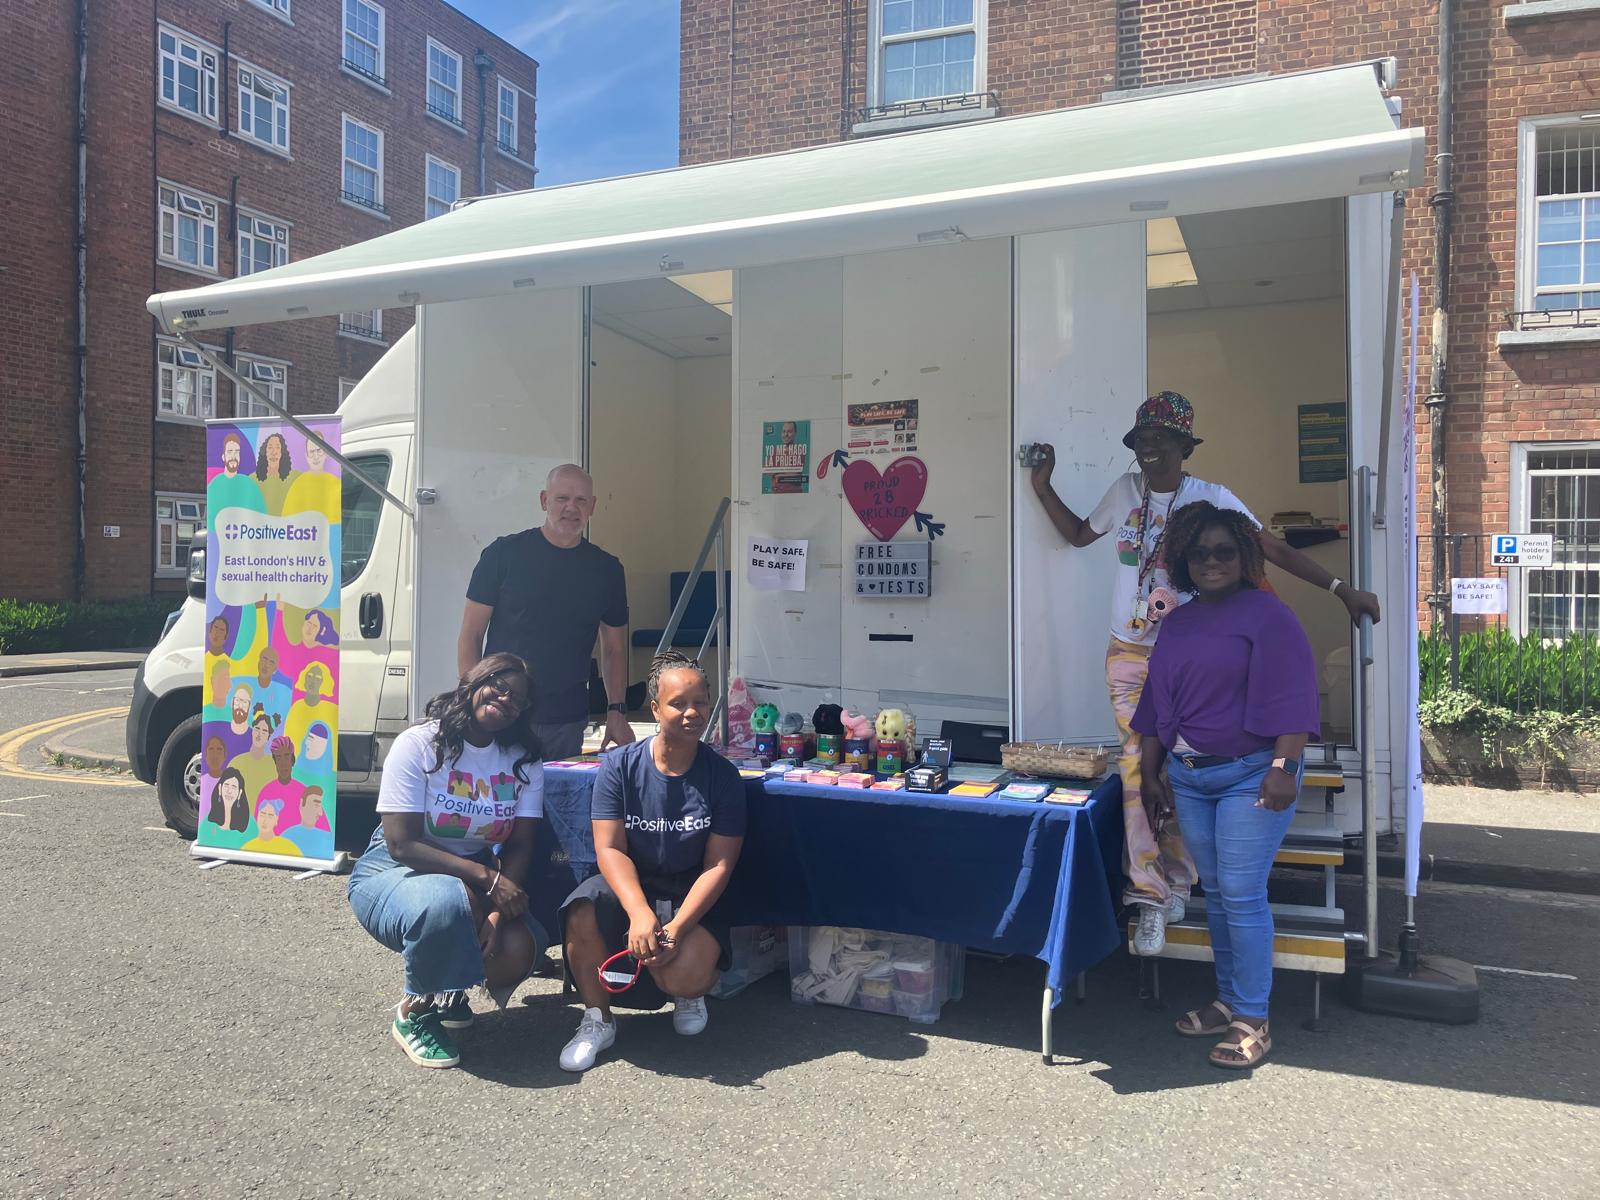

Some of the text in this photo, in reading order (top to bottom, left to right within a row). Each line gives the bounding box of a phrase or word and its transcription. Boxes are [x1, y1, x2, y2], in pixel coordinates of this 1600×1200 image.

[182, 308, 206, 319] THULE
[765, 443, 807, 456] YO ME HAGO
[764, 455, 804, 467] LA PRUEBA.
[863, 476, 900, 491] PROUD
[874, 491, 895, 505] 2 B
[240, 524, 317, 541] PositiveEast
[753, 544, 805, 558] PLAY SAFE,
[859, 545, 893, 559] FREE
[1501, 538, 1514, 553] P
[224, 555, 326, 567] East London's HIV &
[752, 558, 795, 571] BE SAFE!
[858, 562, 918, 576] CONDOMS
[221, 571, 328, 586] sexual health charity
[857, 580, 925, 595] & TESTS
